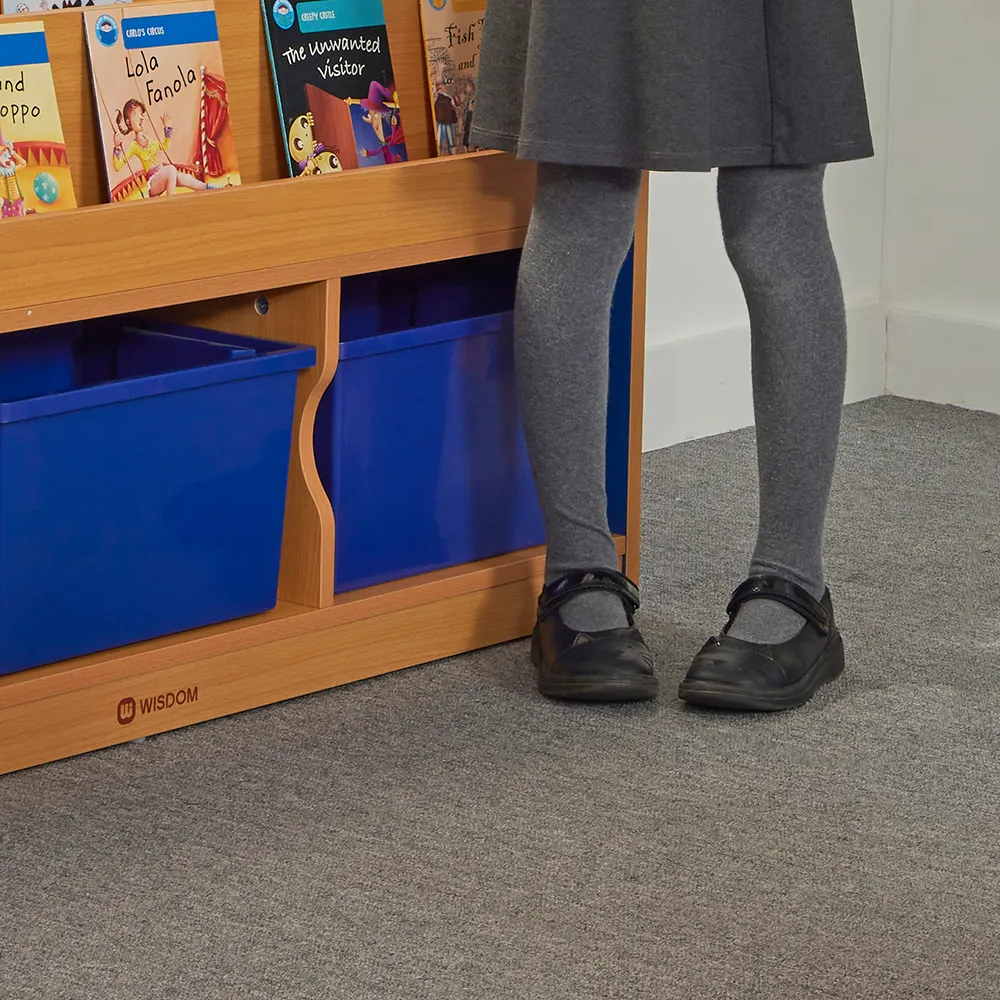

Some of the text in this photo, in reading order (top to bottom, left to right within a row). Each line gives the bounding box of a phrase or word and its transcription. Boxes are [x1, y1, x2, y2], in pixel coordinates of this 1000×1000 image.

[147, 26, 165, 36] CIRCUS
[444, 22, 476, 48] Fish
[125, 50, 159, 78] Lola
[282, 36, 381, 66] The Unwanted
[458, 54, 478, 71] and
[146, 65, 196, 106] Fanola
[140, 686, 198, 714] WISDOM
